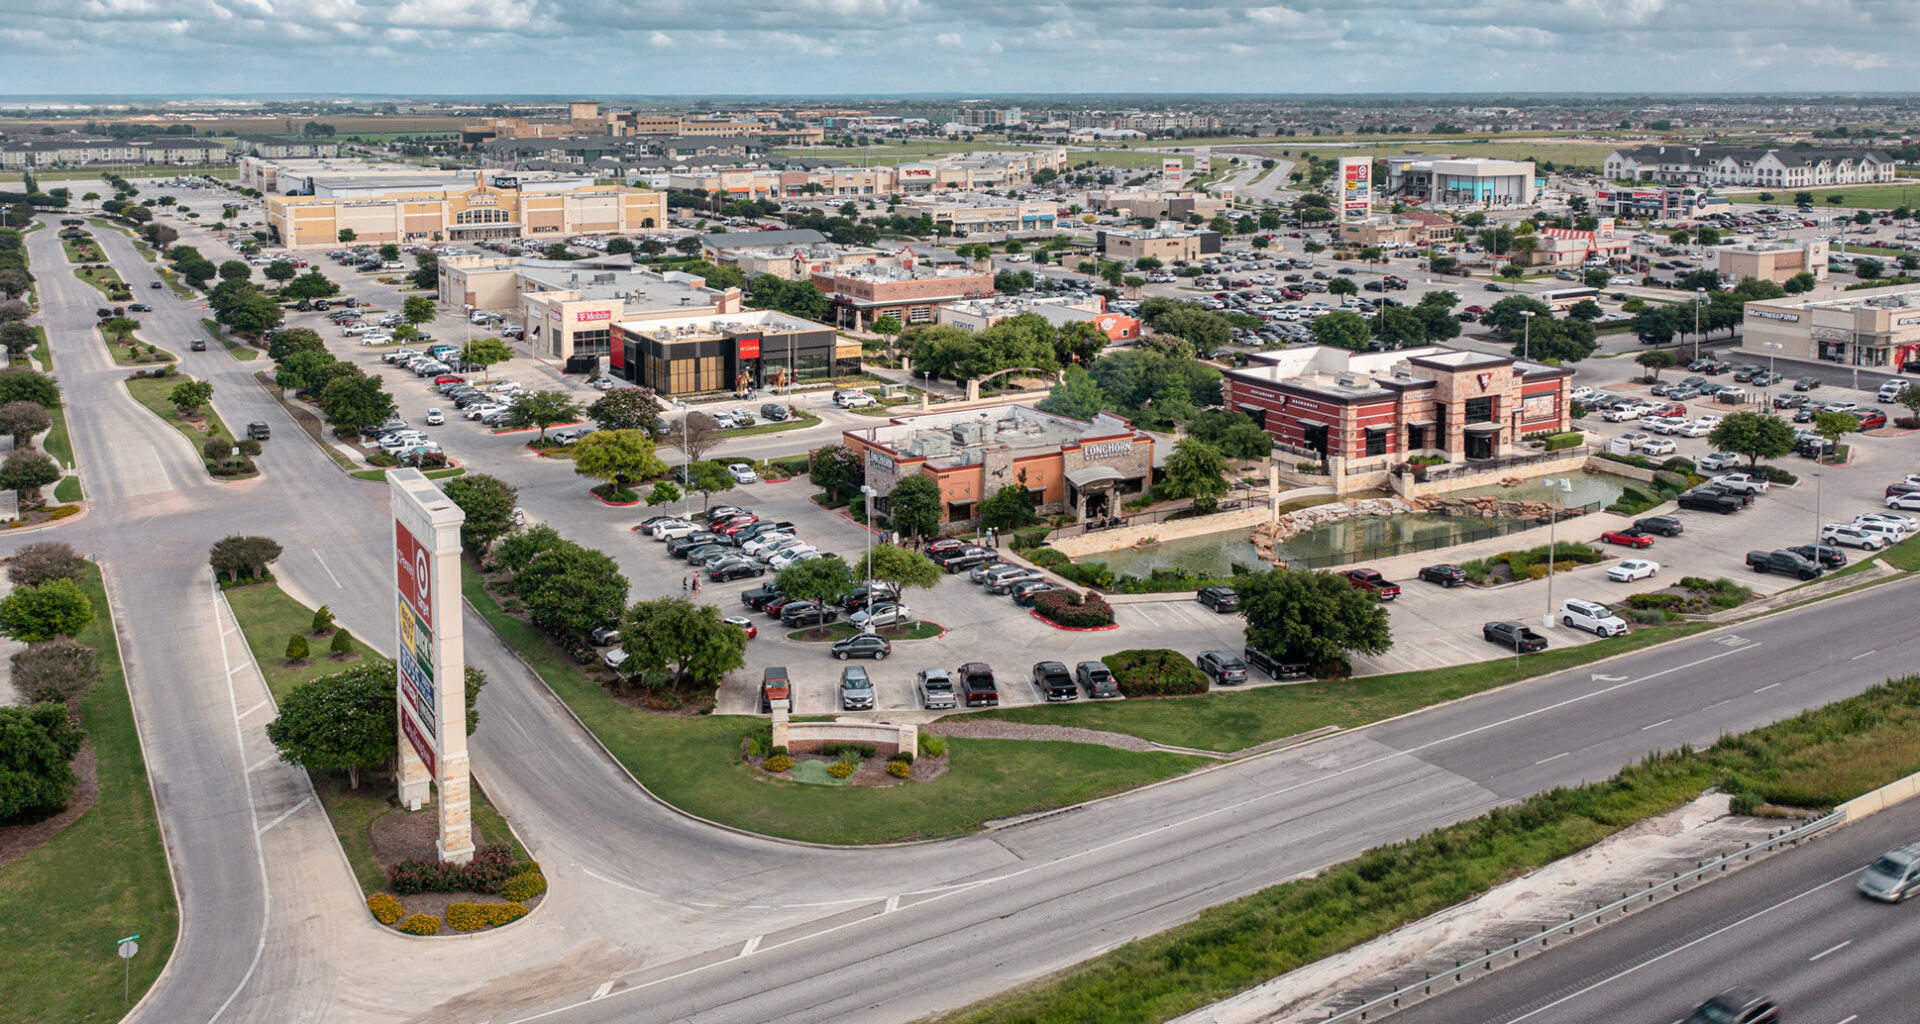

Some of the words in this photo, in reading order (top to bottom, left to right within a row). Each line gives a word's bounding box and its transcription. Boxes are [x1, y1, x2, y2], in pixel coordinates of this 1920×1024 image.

[586, 311, 610, 320] Mobile
[1084, 441, 1132, 457] LONGHORN
[869, 449, 894, 469] LONGHORN
[401, 648, 420, 687] ROSS
